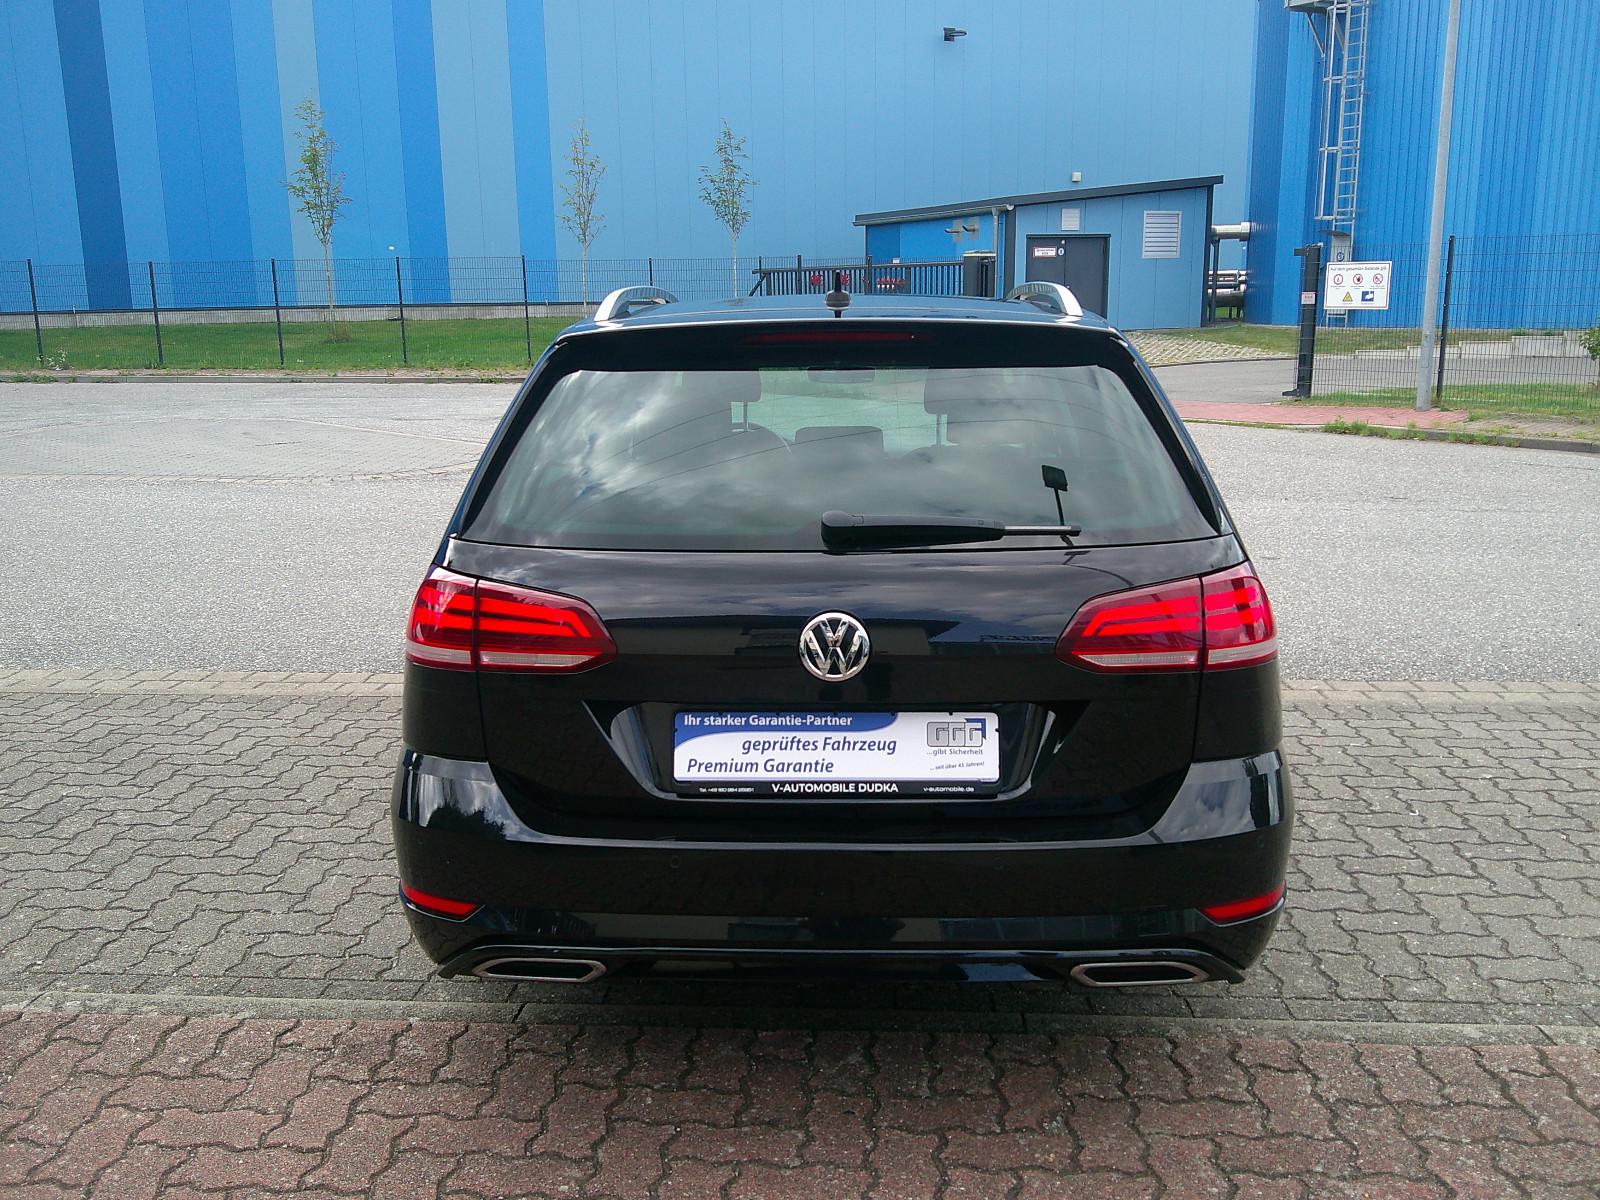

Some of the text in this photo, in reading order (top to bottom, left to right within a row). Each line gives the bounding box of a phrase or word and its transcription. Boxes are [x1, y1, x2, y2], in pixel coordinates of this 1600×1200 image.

[684, 715, 853, 726] Ihr starker Garantie-Partner
[742, 736, 897, 755] geprüftes Fahrzeug
[687, 758, 834, 773] Premium Garantie
[772, 783, 899, 793] V-AUTOMOBILE DUDKA
